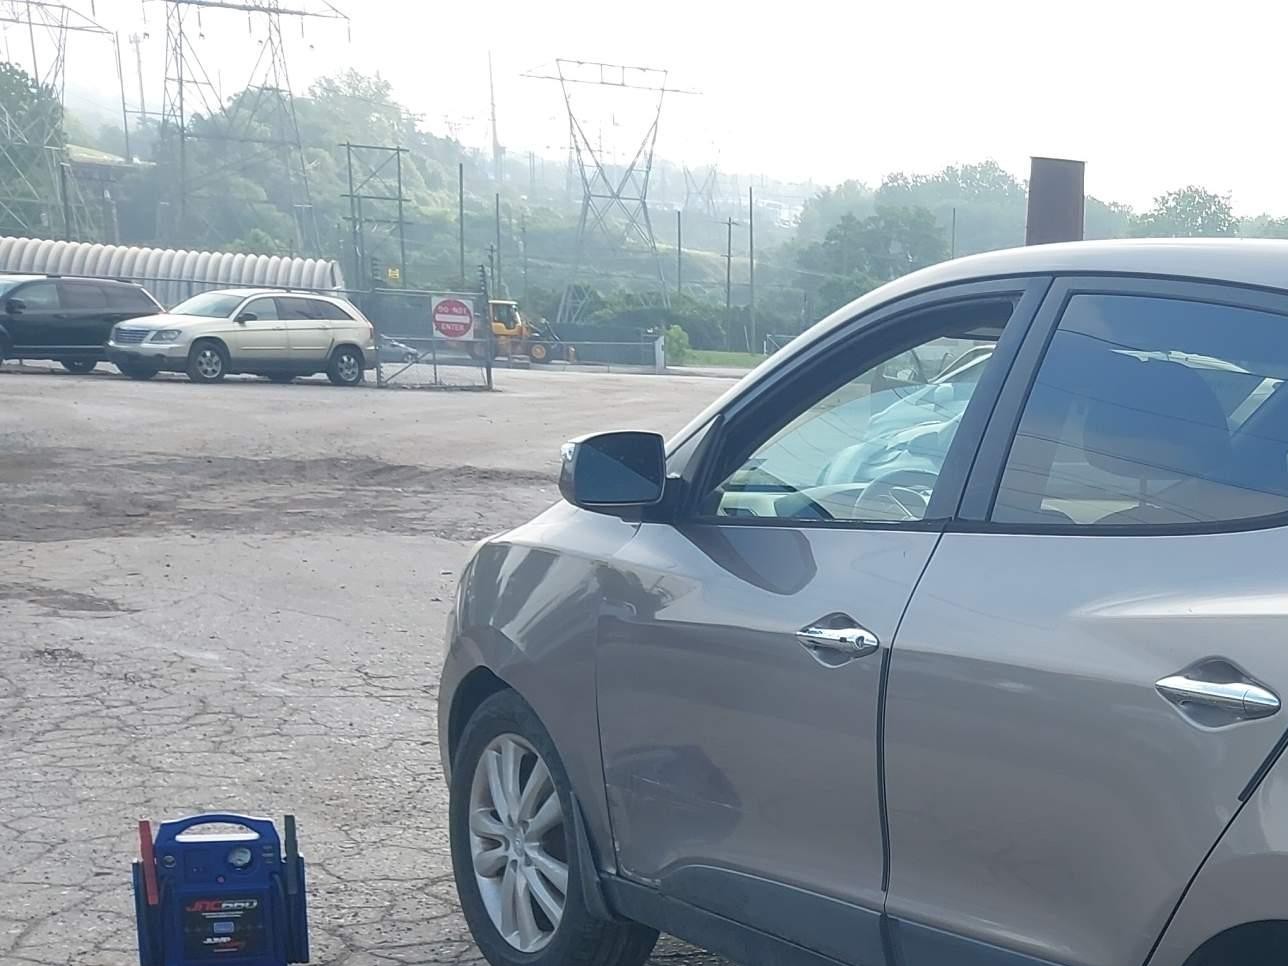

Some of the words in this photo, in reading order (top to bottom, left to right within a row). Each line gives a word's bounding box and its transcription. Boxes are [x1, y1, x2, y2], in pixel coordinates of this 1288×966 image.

[437, 305, 449, 313] DO
[452, 306, 467, 315] NOT
[440, 322, 466, 331] ENTER
